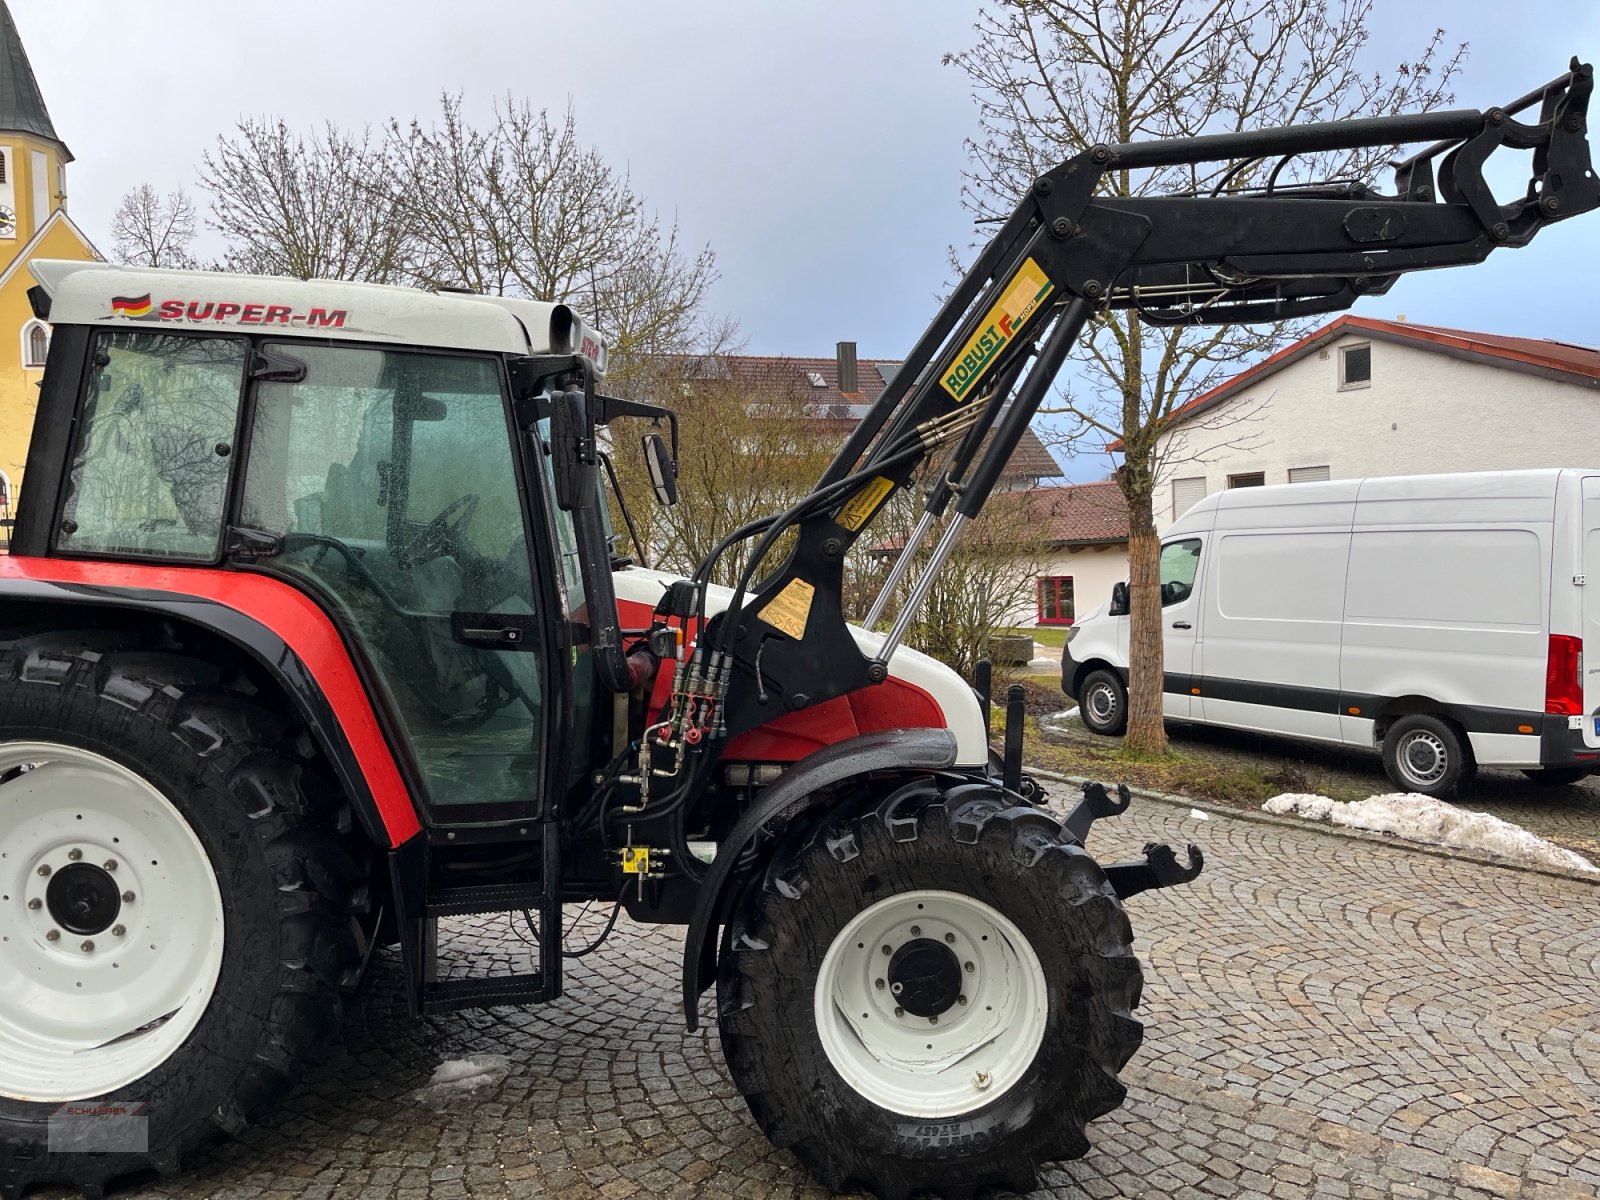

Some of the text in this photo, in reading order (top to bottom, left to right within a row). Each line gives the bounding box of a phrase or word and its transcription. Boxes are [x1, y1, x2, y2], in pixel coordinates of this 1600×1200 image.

[158, 300, 348, 328] SUPER-M
[945, 313, 1013, 394] ROBUST F
